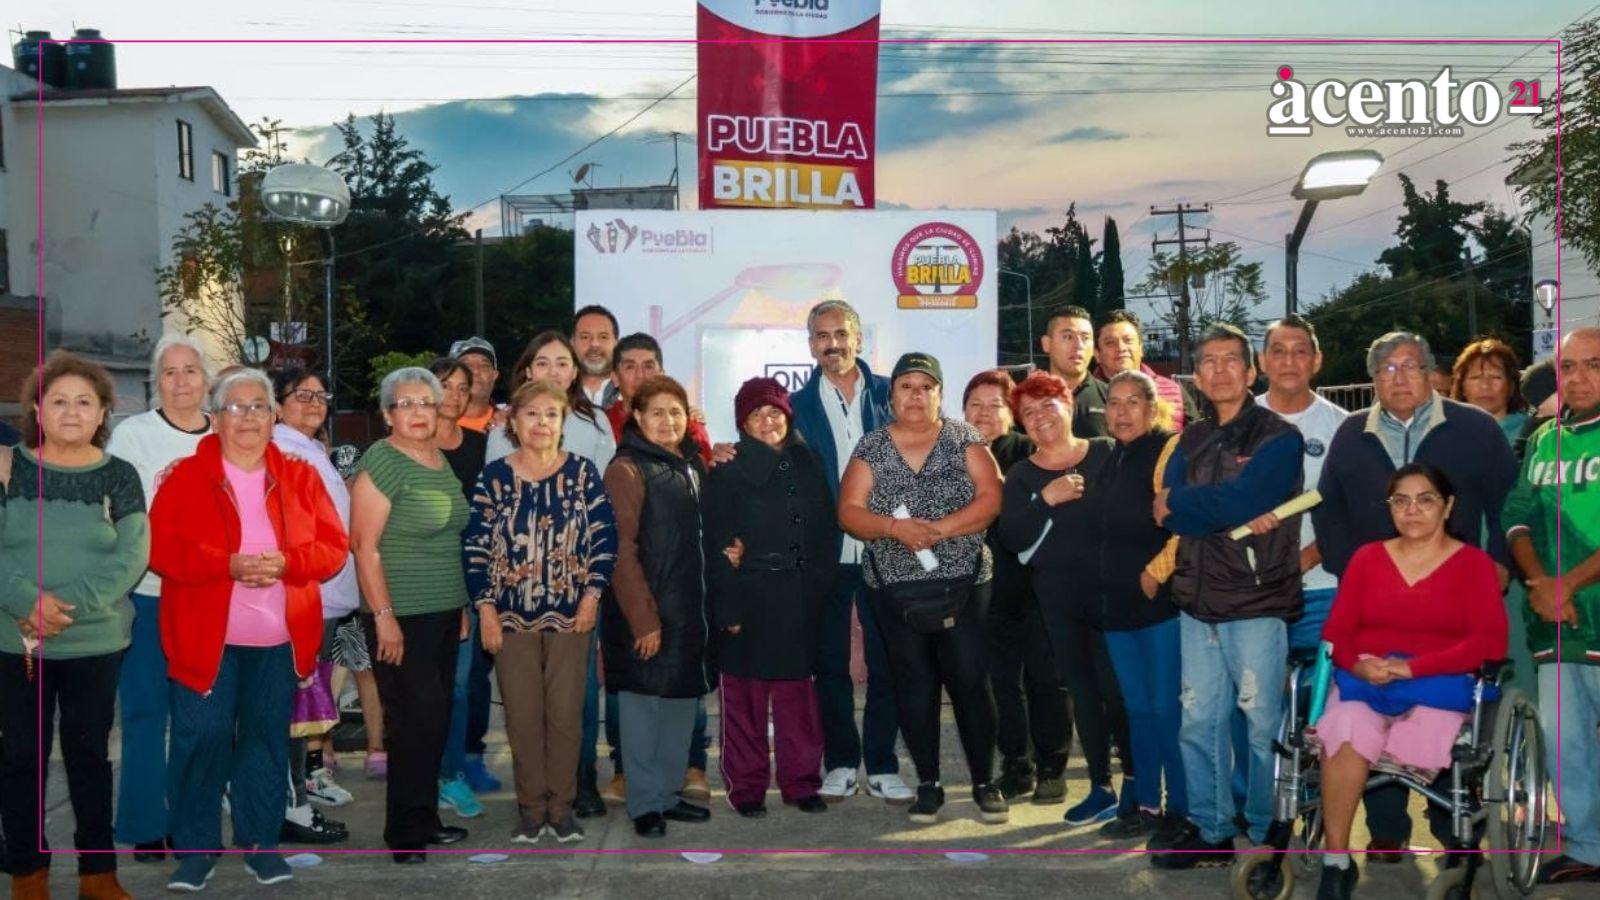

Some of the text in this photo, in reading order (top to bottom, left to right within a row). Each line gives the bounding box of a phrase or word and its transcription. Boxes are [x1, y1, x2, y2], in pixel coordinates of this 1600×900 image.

[707, 114, 868, 160] PUEBLA
[713, 165, 865, 206] BRILLA
[641, 229, 707, 247] Puebla
[907, 264, 972, 285] BRILLA
[773, 370, 808, 391] ON
